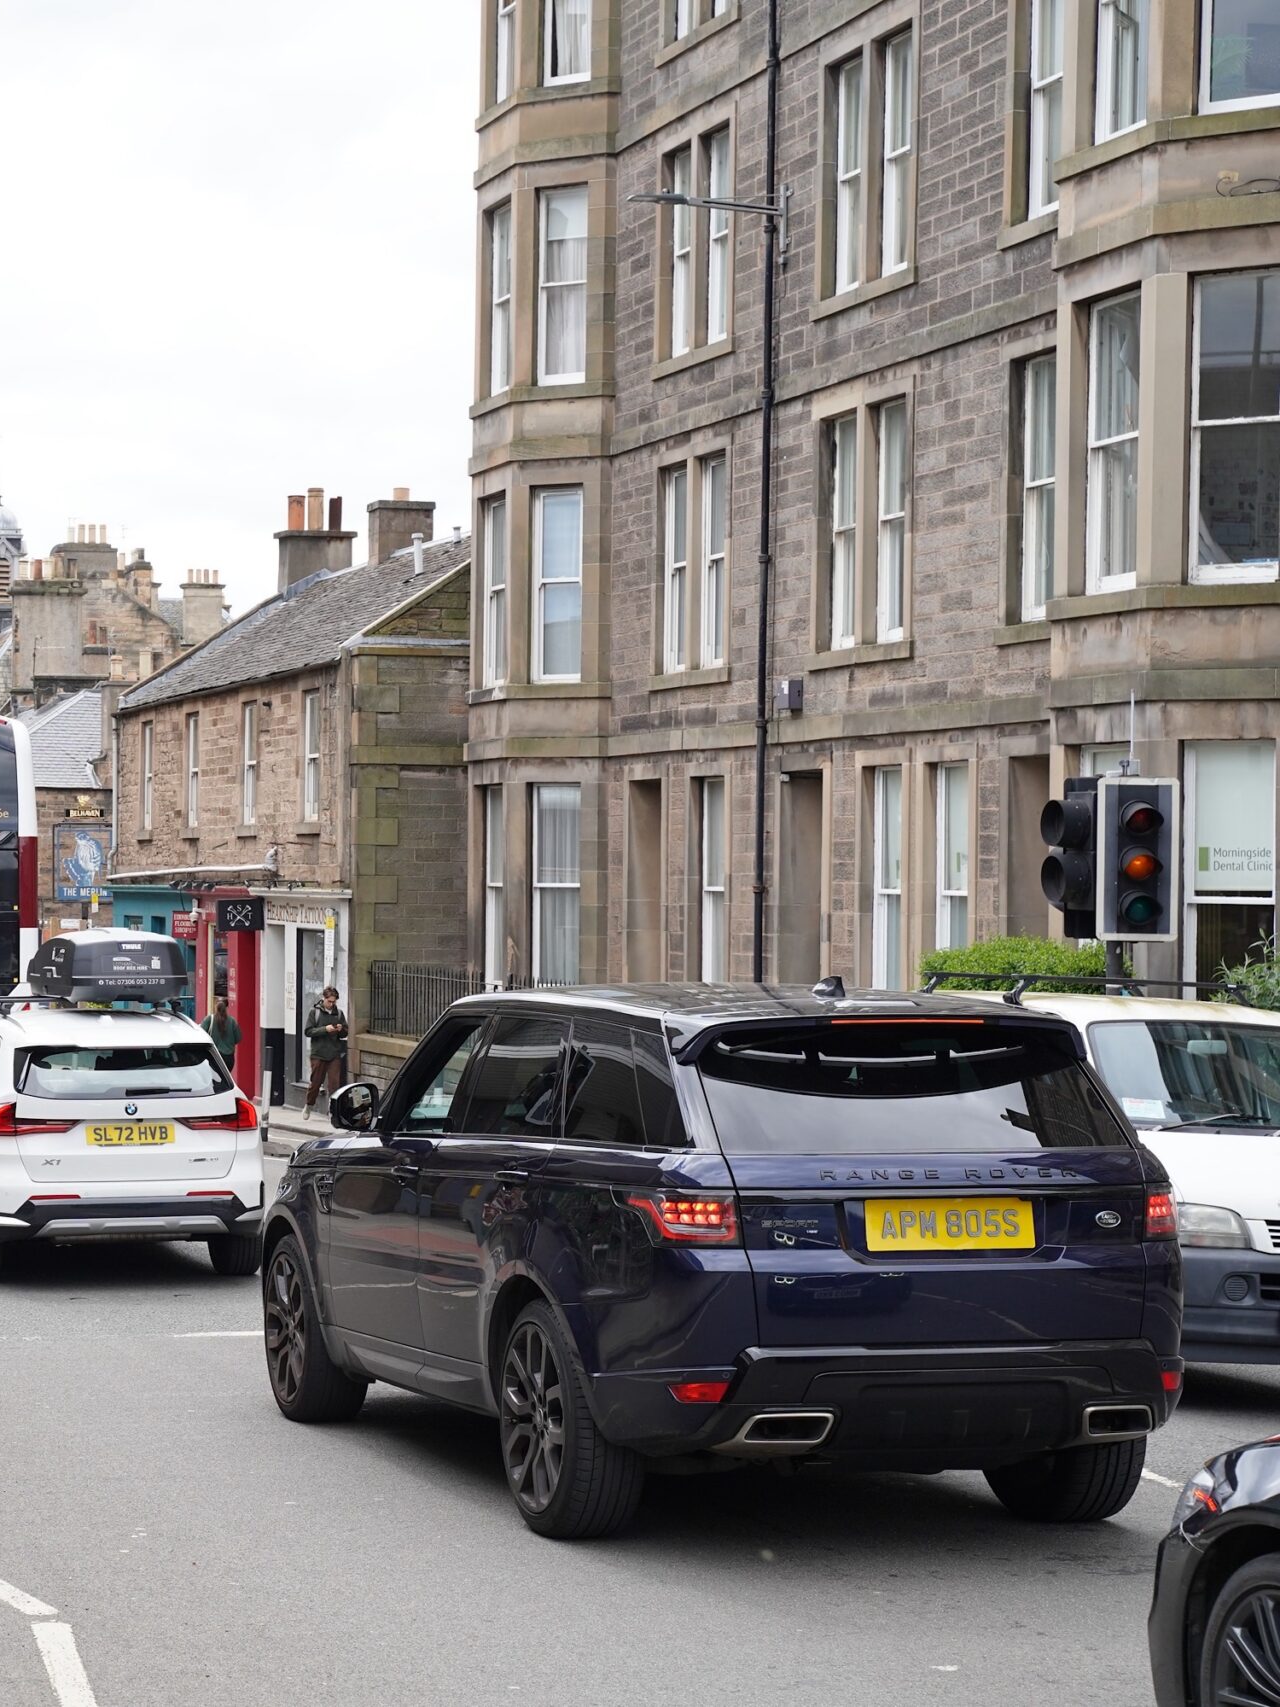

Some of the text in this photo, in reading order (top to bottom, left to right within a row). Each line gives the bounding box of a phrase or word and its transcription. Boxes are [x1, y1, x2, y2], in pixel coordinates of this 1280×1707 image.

[69, 809, 100, 817] BELHAVEN
[1213, 847, 1272, 860] Morningside
[1213, 861, 1273, 871] Dental Clinic
[63, 887, 108, 897] THE MERLIN
[93, 1125, 168, 1142] SL72 HVB
[819, 1167, 1078, 1181] RANGE ROVER
[881, 1209, 1020, 1239] APM 805S
